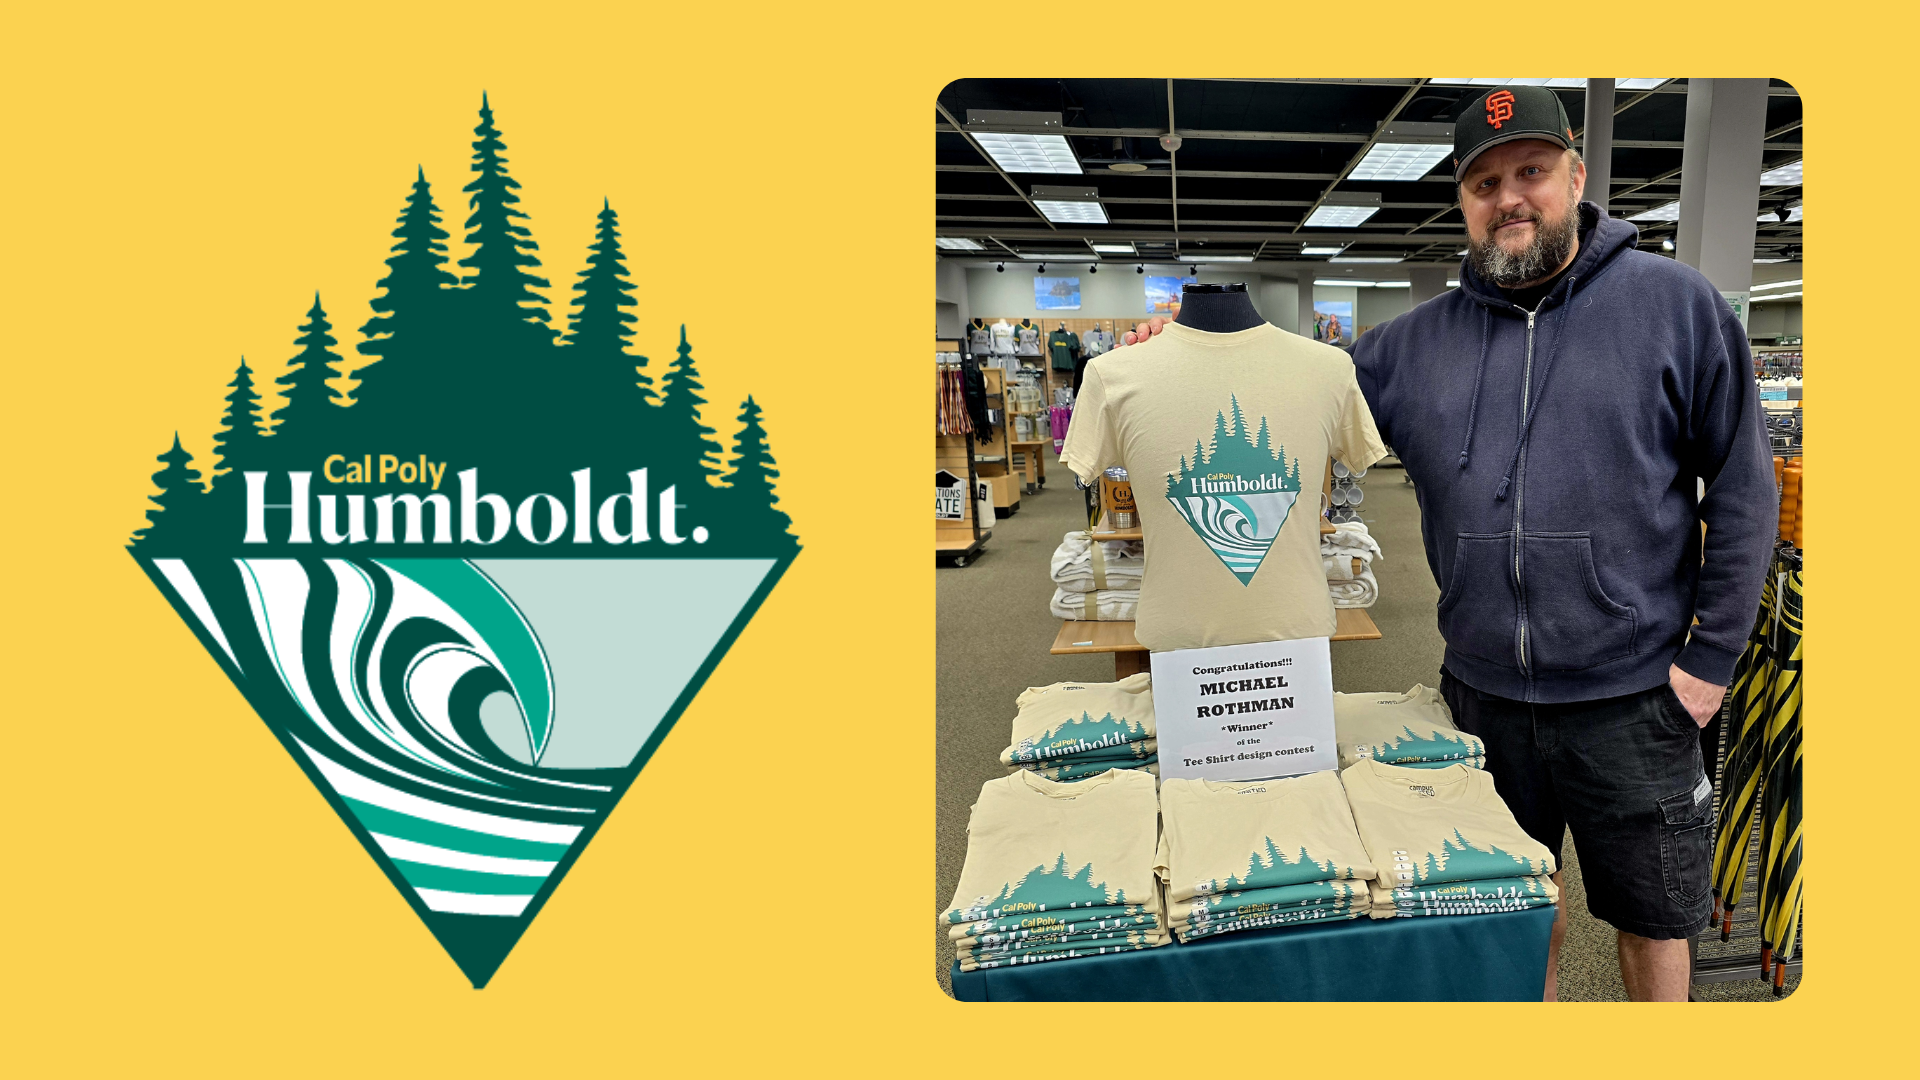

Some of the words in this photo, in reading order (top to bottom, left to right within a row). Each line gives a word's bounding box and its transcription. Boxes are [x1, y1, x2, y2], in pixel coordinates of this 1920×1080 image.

[1219, 472, 1234, 480] Poly
[1190, 473, 1288, 494] Humboldt.
[936, 489, 960, 498] TIONS
[1192, 658, 1292, 675] Congratulations!!!
[1200, 676, 1288, 696] MICHAEL
[1197, 697, 1294, 718] ROTHMAN
[1051, 739, 1062, 748] Cal
[1063, 737, 1077, 747] Poly
[1247, 737, 1261, 745] the
[1183, 758, 1203, 767] Tee
[1206, 754, 1235, 765] Shirt
[1237, 750, 1272, 761] design
[1275, 745, 1315, 756] contest
[1450, 885, 1468, 894] Poly
[1002, 904, 1017, 912] Cal
[1017, 902, 1037, 911] Poly
[1238, 904, 1250, 914] Cal
[1251, 903, 1270, 912] Poly
[1021, 918, 1035, 927] Cal
[1037, 917, 1056, 926] Poly
